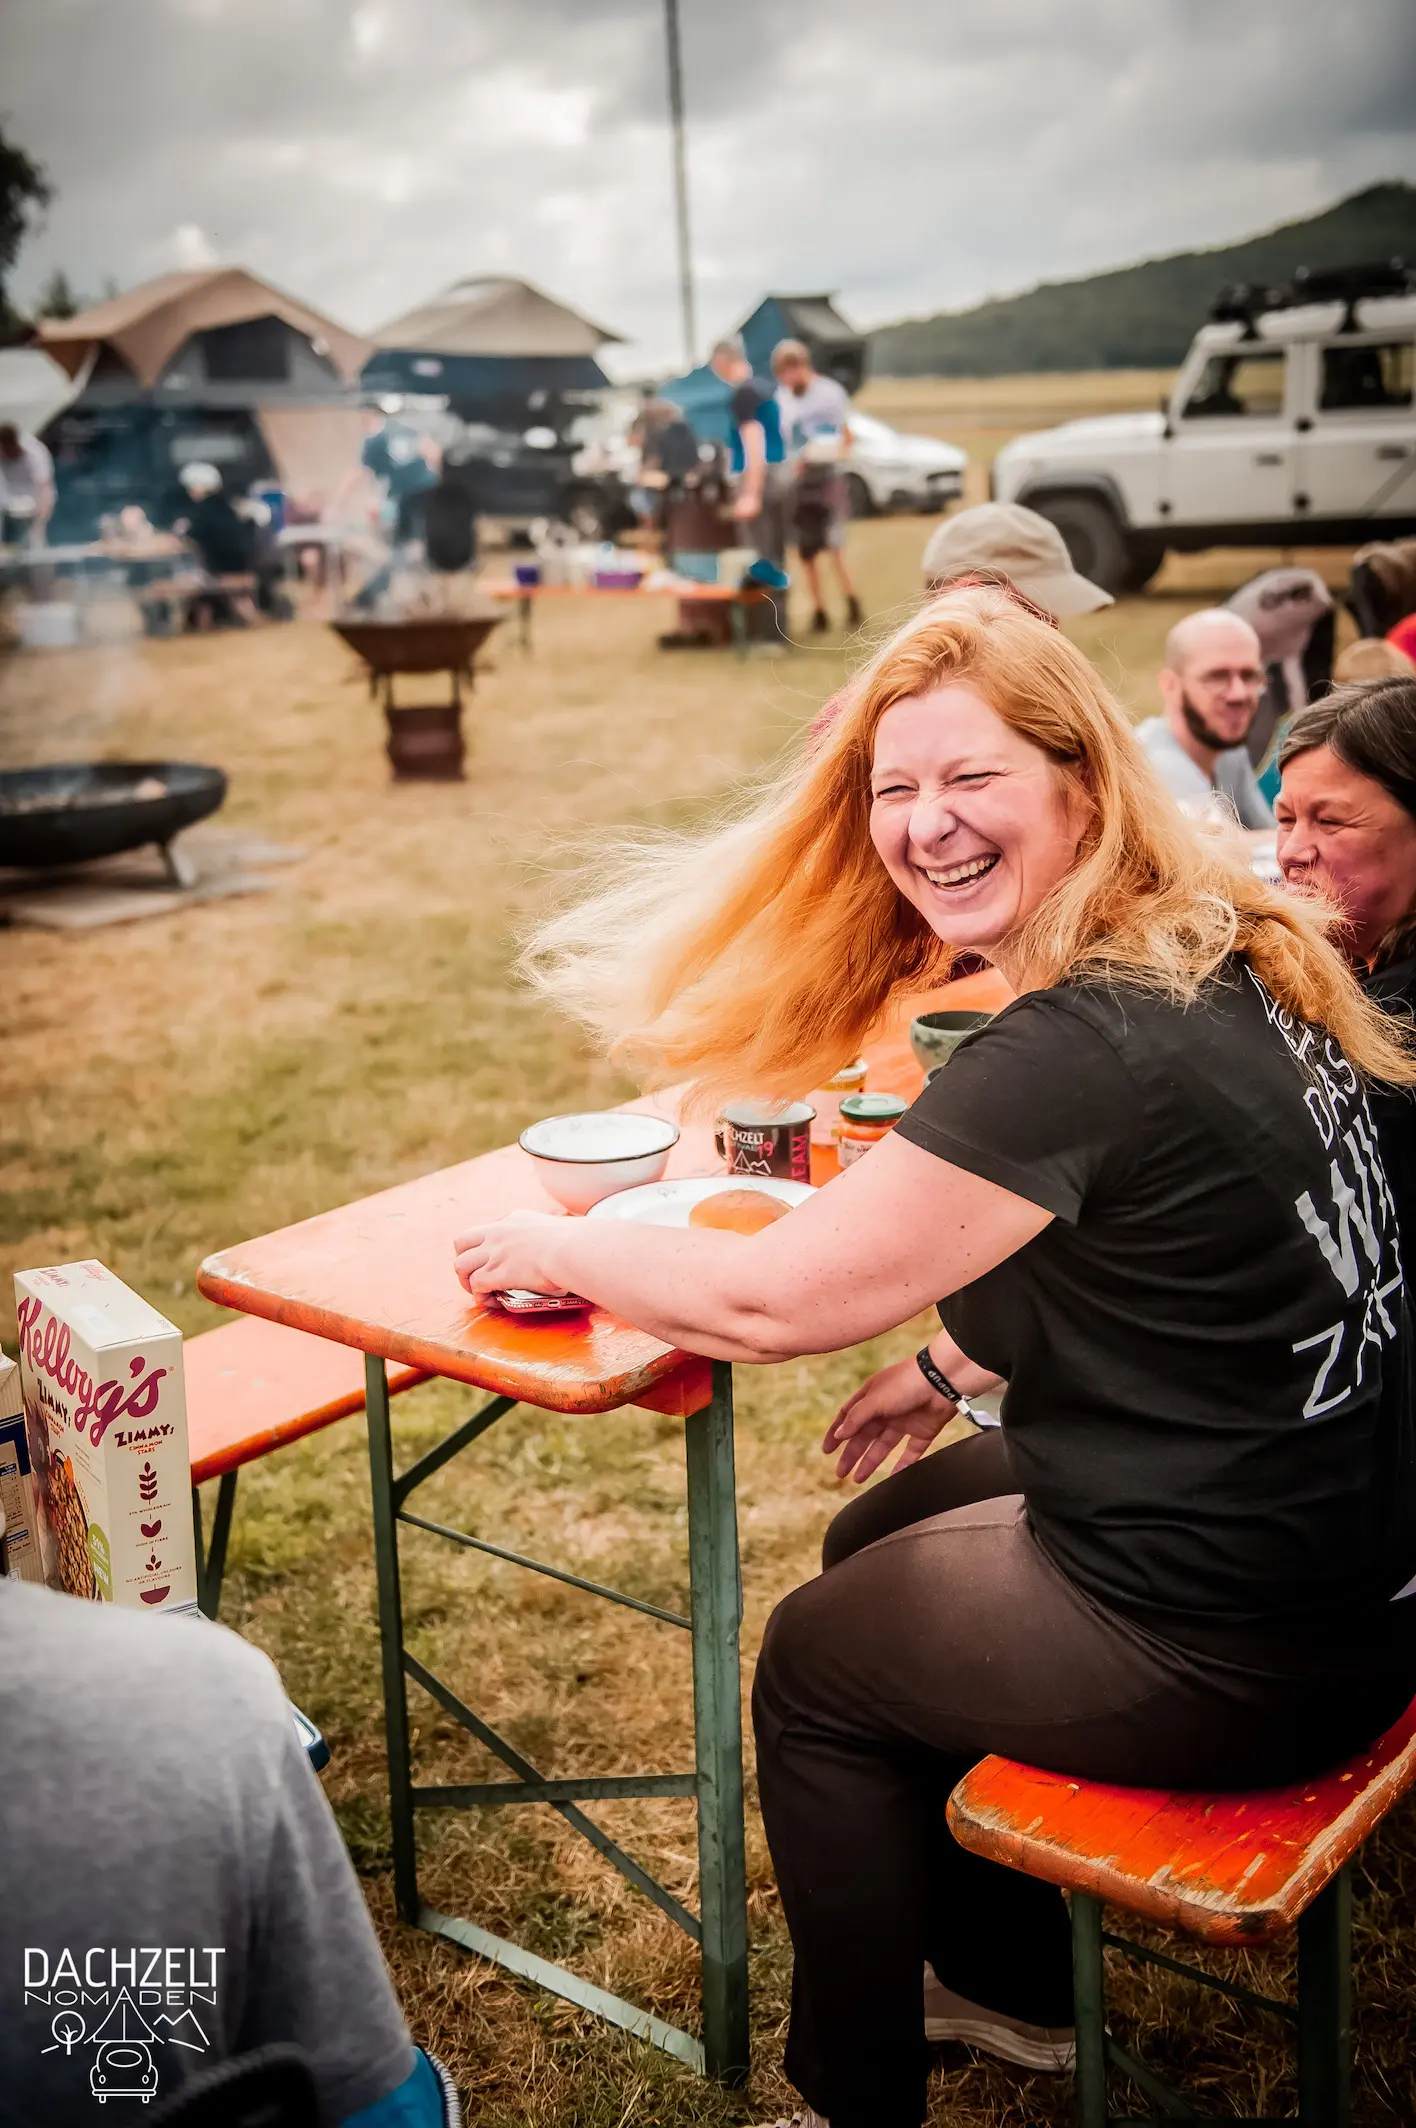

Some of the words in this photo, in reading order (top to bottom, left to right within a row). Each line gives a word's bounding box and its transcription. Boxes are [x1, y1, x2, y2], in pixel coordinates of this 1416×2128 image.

[1302, 1037, 1358, 1151] DAS
[757, 1140, 774, 1160] 19
[791, 1135, 807, 1183] EAM
[17, 1296, 168, 1448] Kellogg's
[128, 1440, 163, 1451] CINNAMON
[137, 1447, 156, 1456] STARS
